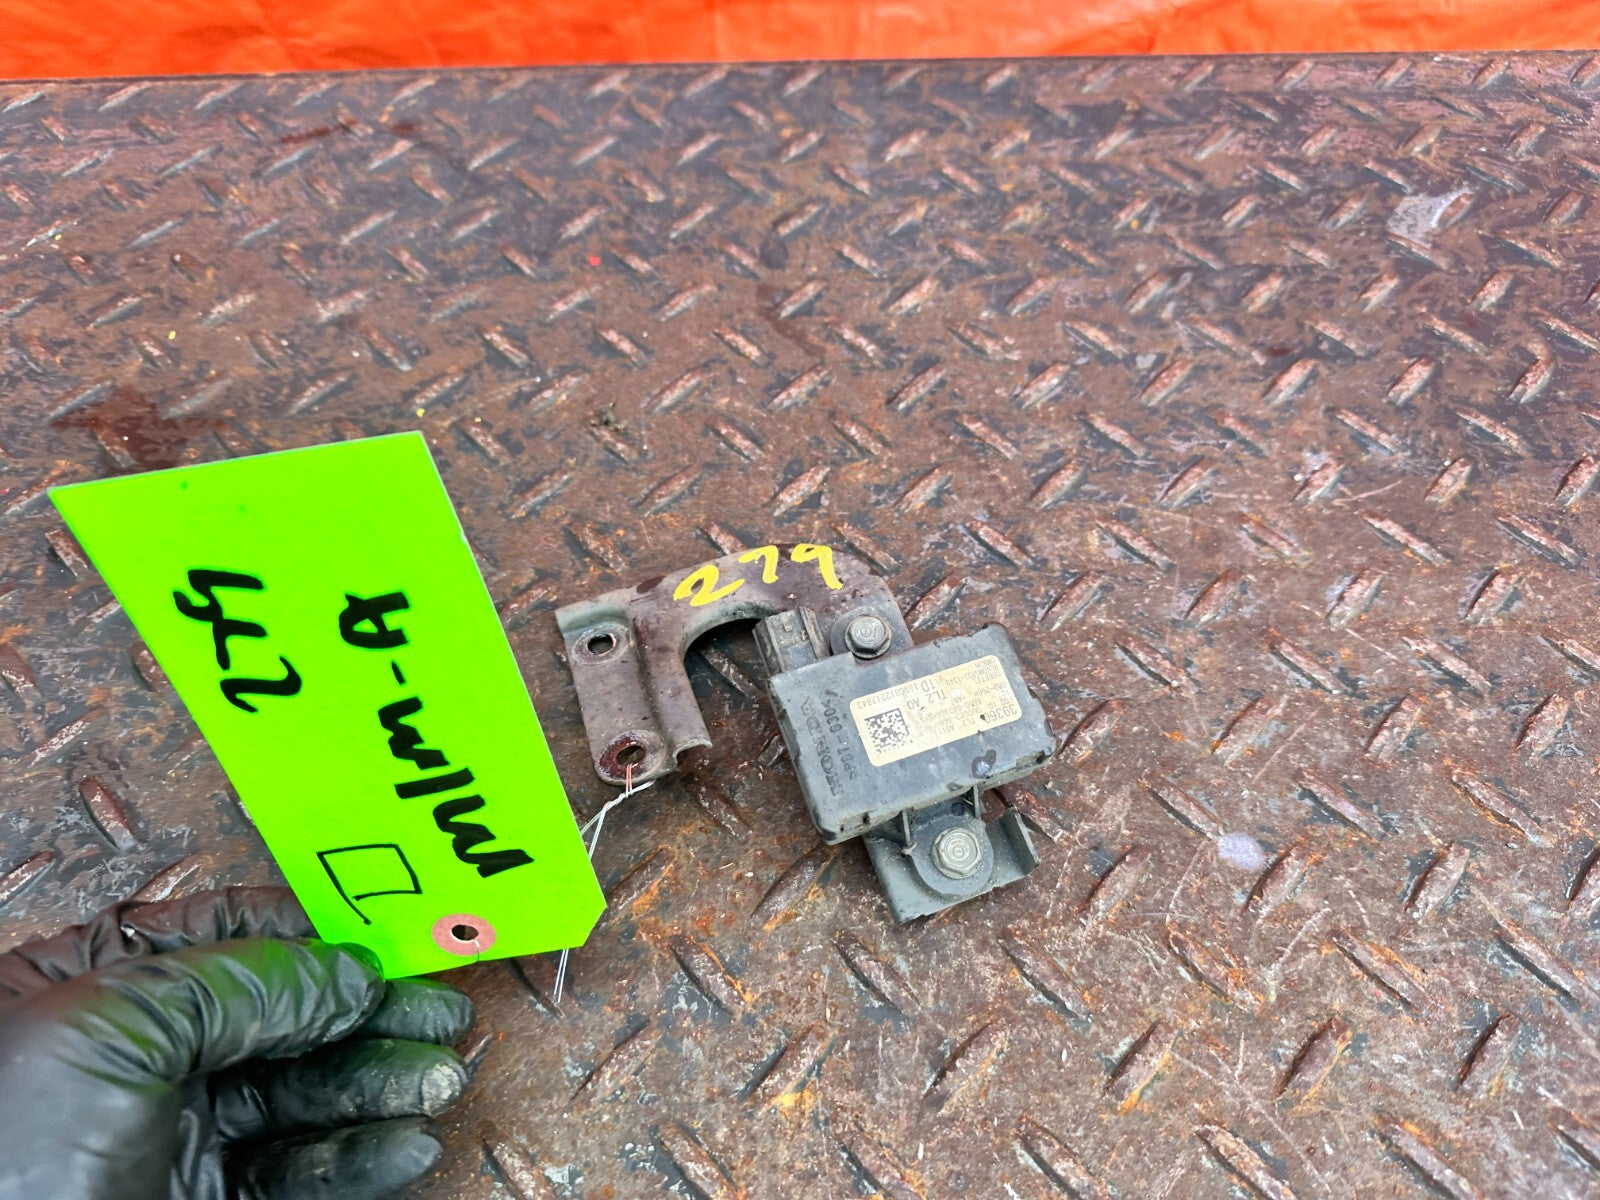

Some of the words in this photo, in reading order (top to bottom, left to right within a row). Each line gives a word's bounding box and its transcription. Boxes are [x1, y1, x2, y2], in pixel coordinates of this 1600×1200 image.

[673, 543, 843, 607] 279
[925, 689, 947, 703] TL2
[981, 703, 1017, 723] 39360
